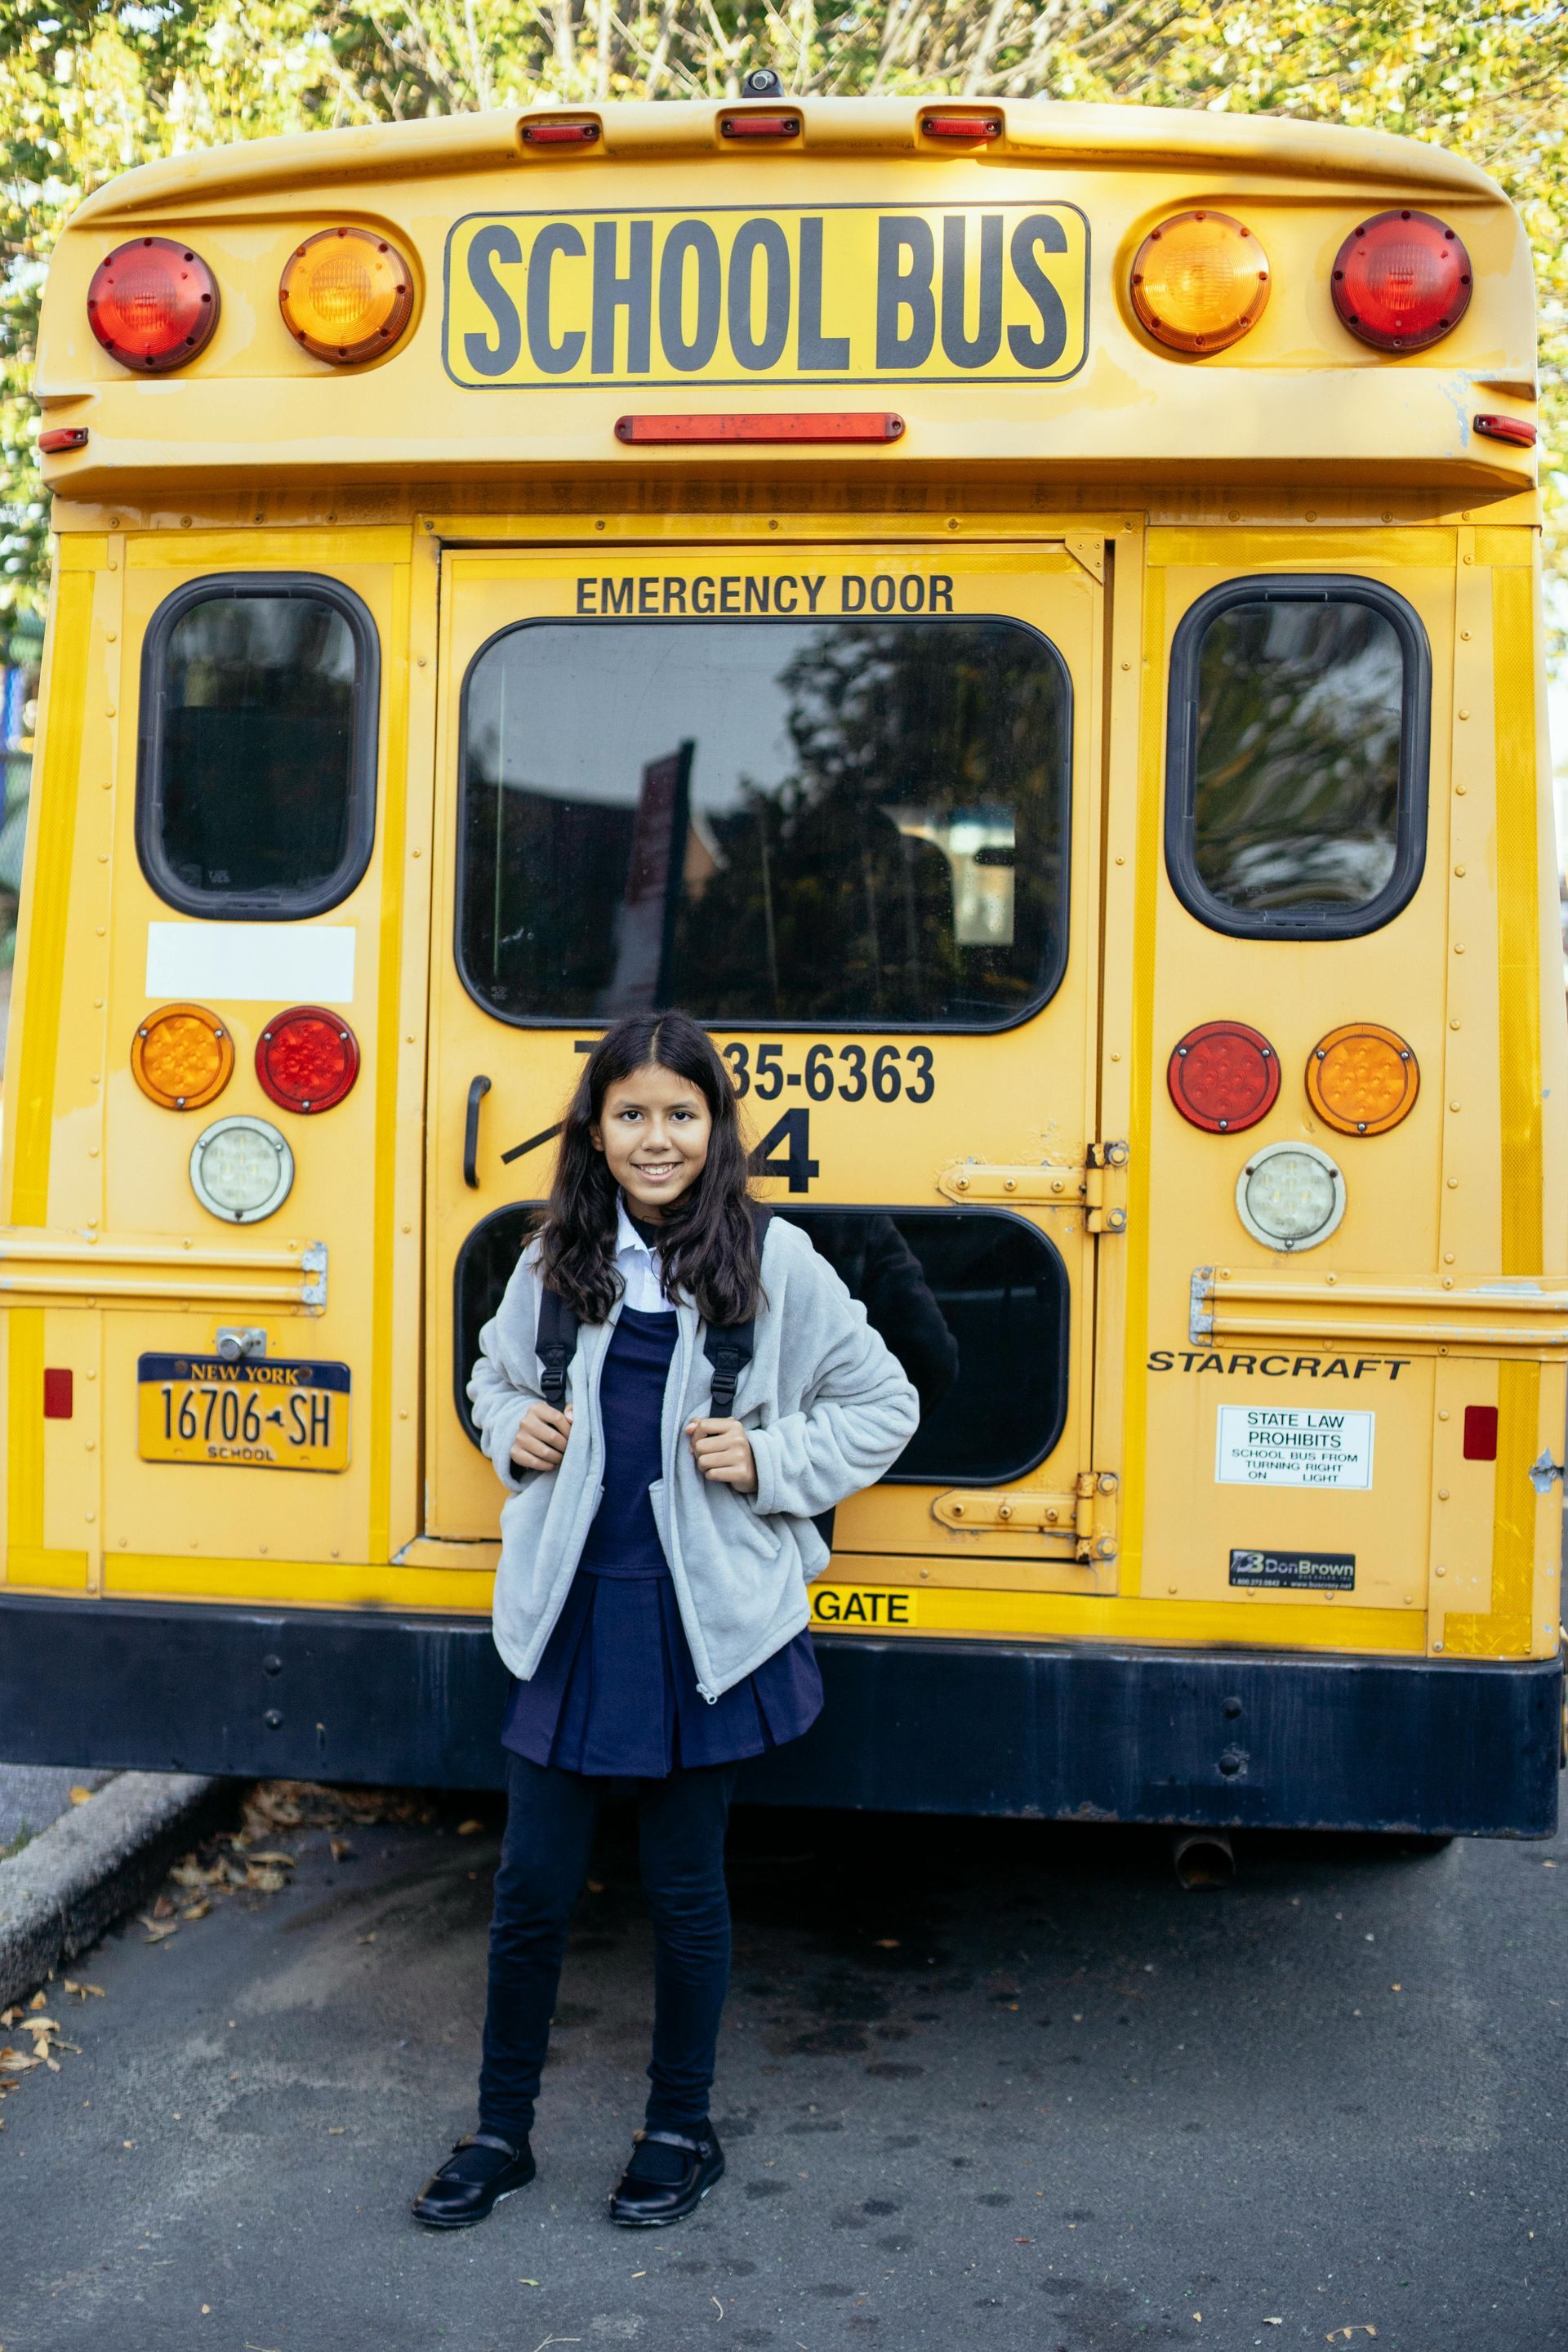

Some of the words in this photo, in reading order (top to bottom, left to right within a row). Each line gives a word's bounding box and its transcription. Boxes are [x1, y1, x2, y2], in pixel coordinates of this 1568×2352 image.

[464, 216, 849, 376] SCHOOL
[875, 213, 1067, 370] BUS
[576, 576, 826, 614] EMERGENCY
[841, 574, 954, 612] DOOR
[723, 1042, 935, 1103] 35-6363
[191, 1363, 240, 1381] NEW
[246, 1366, 300, 1385] YORK
[1147, 1350, 1411, 1381] STARCRAFT
[162, 1388, 261, 1442] 16706
[1247, 1412, 1298, 1427] STATE
[1307, 1414, 1344, 1428] LAW
[1249, 1432, 1342, 1448] PROHIBITS
[207, 1446, 275, 1461] SCHOOL
[1232, 1449, 1285, 1459] SCHOOL
[1290, 1452, 1316, 1461] BUS
[1321, 1454, 1358, 1463] FROM
[1245, 1460, 1300, 1471] TURNING
[1306, 1463, 1343, 1472] RIGHT
[1248, 1471, 1267, 1480] ON
[1303, 1474, 1339, 1483] LIGHT
[811, 1590, 909, 1624] GATE
